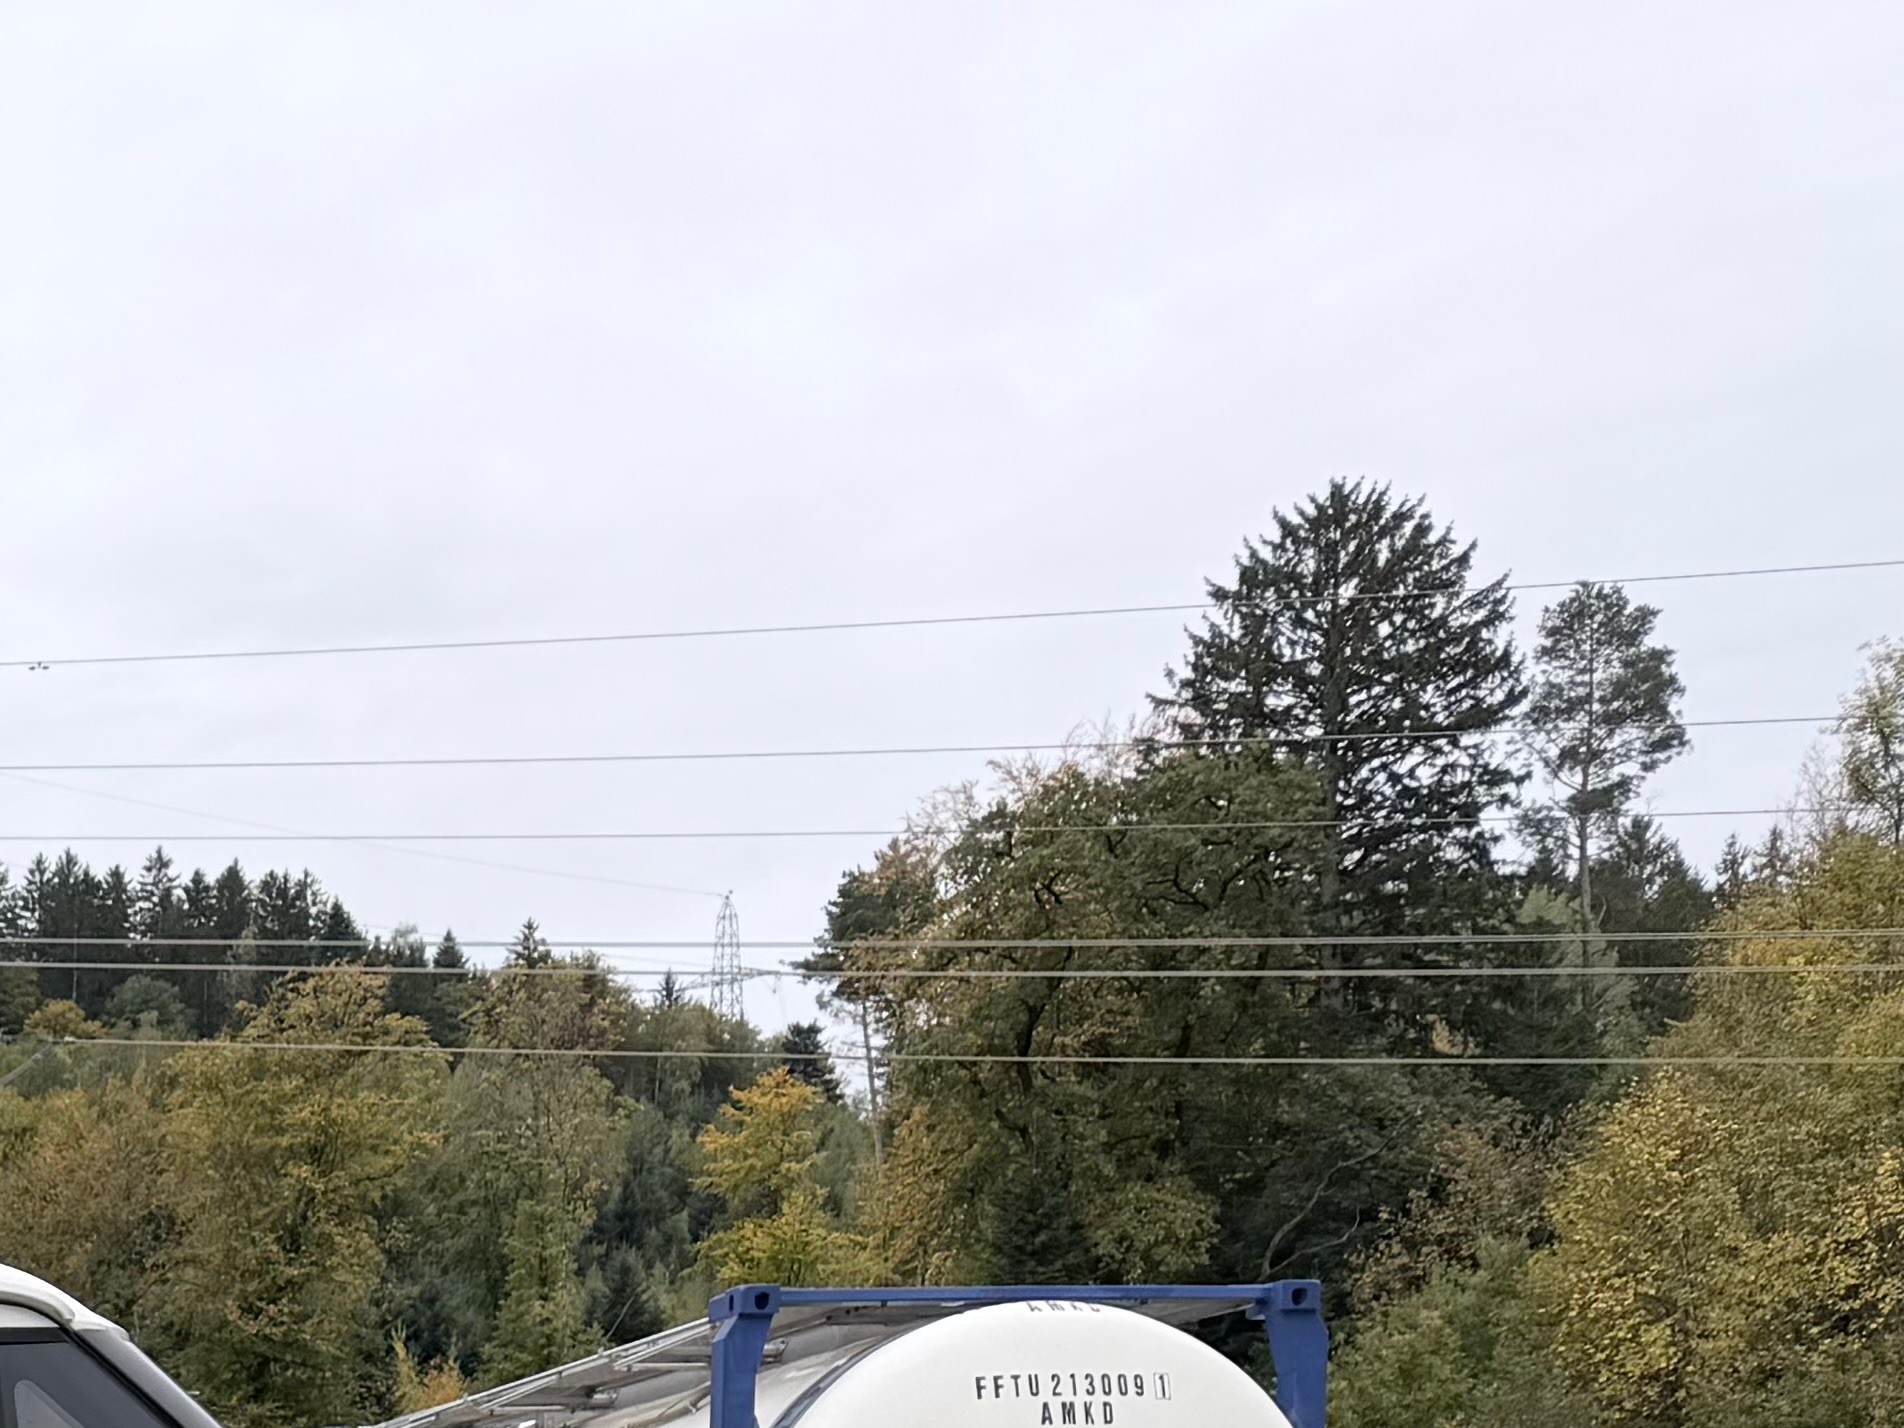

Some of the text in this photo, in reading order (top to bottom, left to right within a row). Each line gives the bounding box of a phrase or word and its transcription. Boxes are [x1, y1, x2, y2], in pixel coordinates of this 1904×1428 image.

[975, 1373, 1040, 1400] FFTU
[1050, 1372, 1145, 1397] 213009
[1041, 1401, 1114, 1426] AMKD
